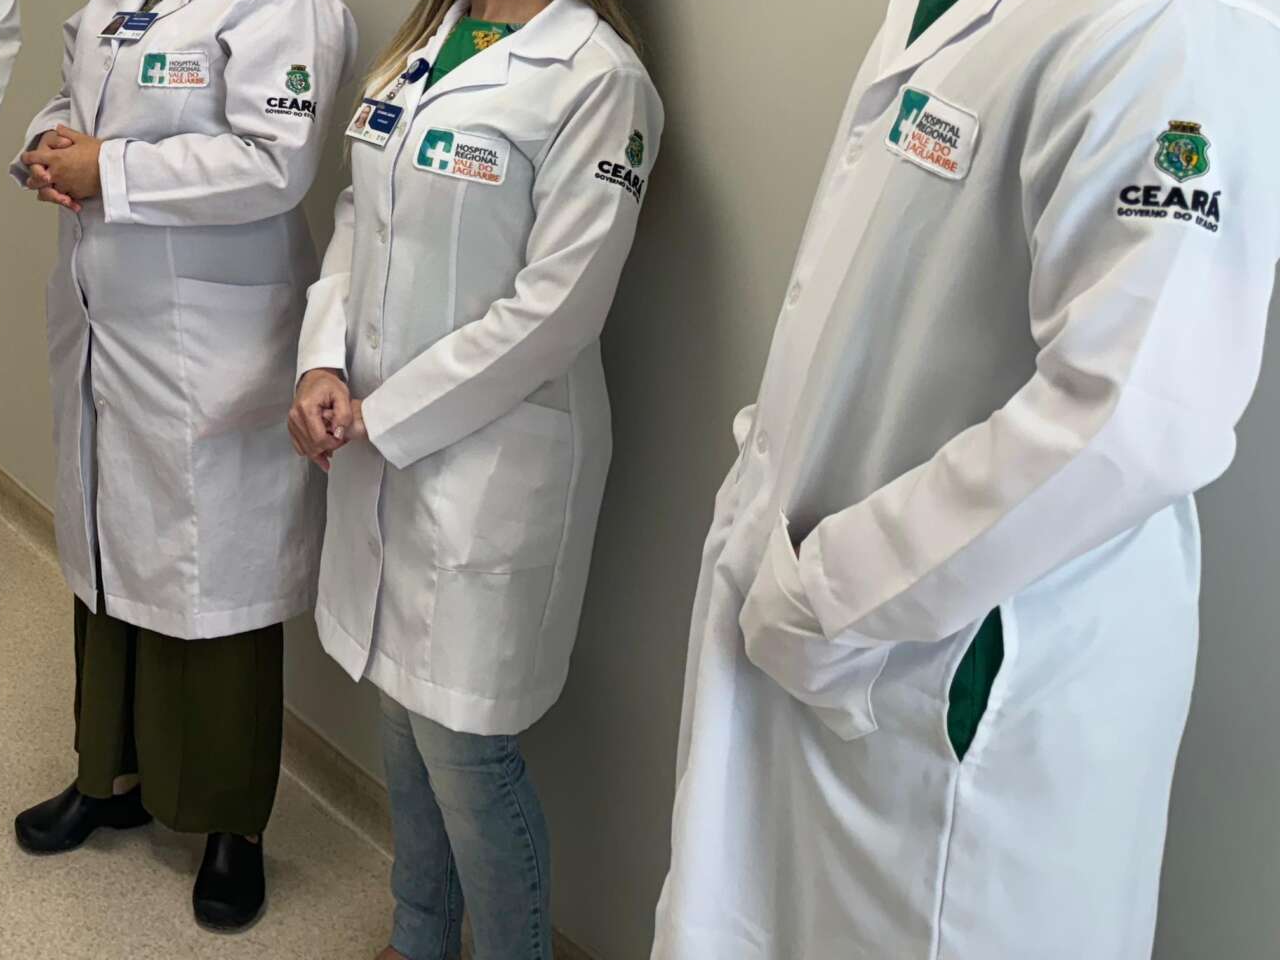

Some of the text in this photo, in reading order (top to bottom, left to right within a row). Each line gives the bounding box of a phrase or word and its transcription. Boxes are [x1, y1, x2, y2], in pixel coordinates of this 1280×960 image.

[915, 121, 959, 149] REGIONAL
[920, 112, 961, 139] HOSPITAL
[455, 143, 498, 159] HOSPITAL
[911, 131, 952, 157] VALE DO
[453, 158, 493, 172] VALE DO
[454, 150, 498, 166] REGIONAL
[904, 140, 958, 173] JAGUARIBE
[452, 166, 502, 182] JAGUARIBE
[1117, 207, 1168, 219] GOVERNO
[1173, 211, 1193, 221] DO
[1119, 185, 1222, 223] CEARÁ
